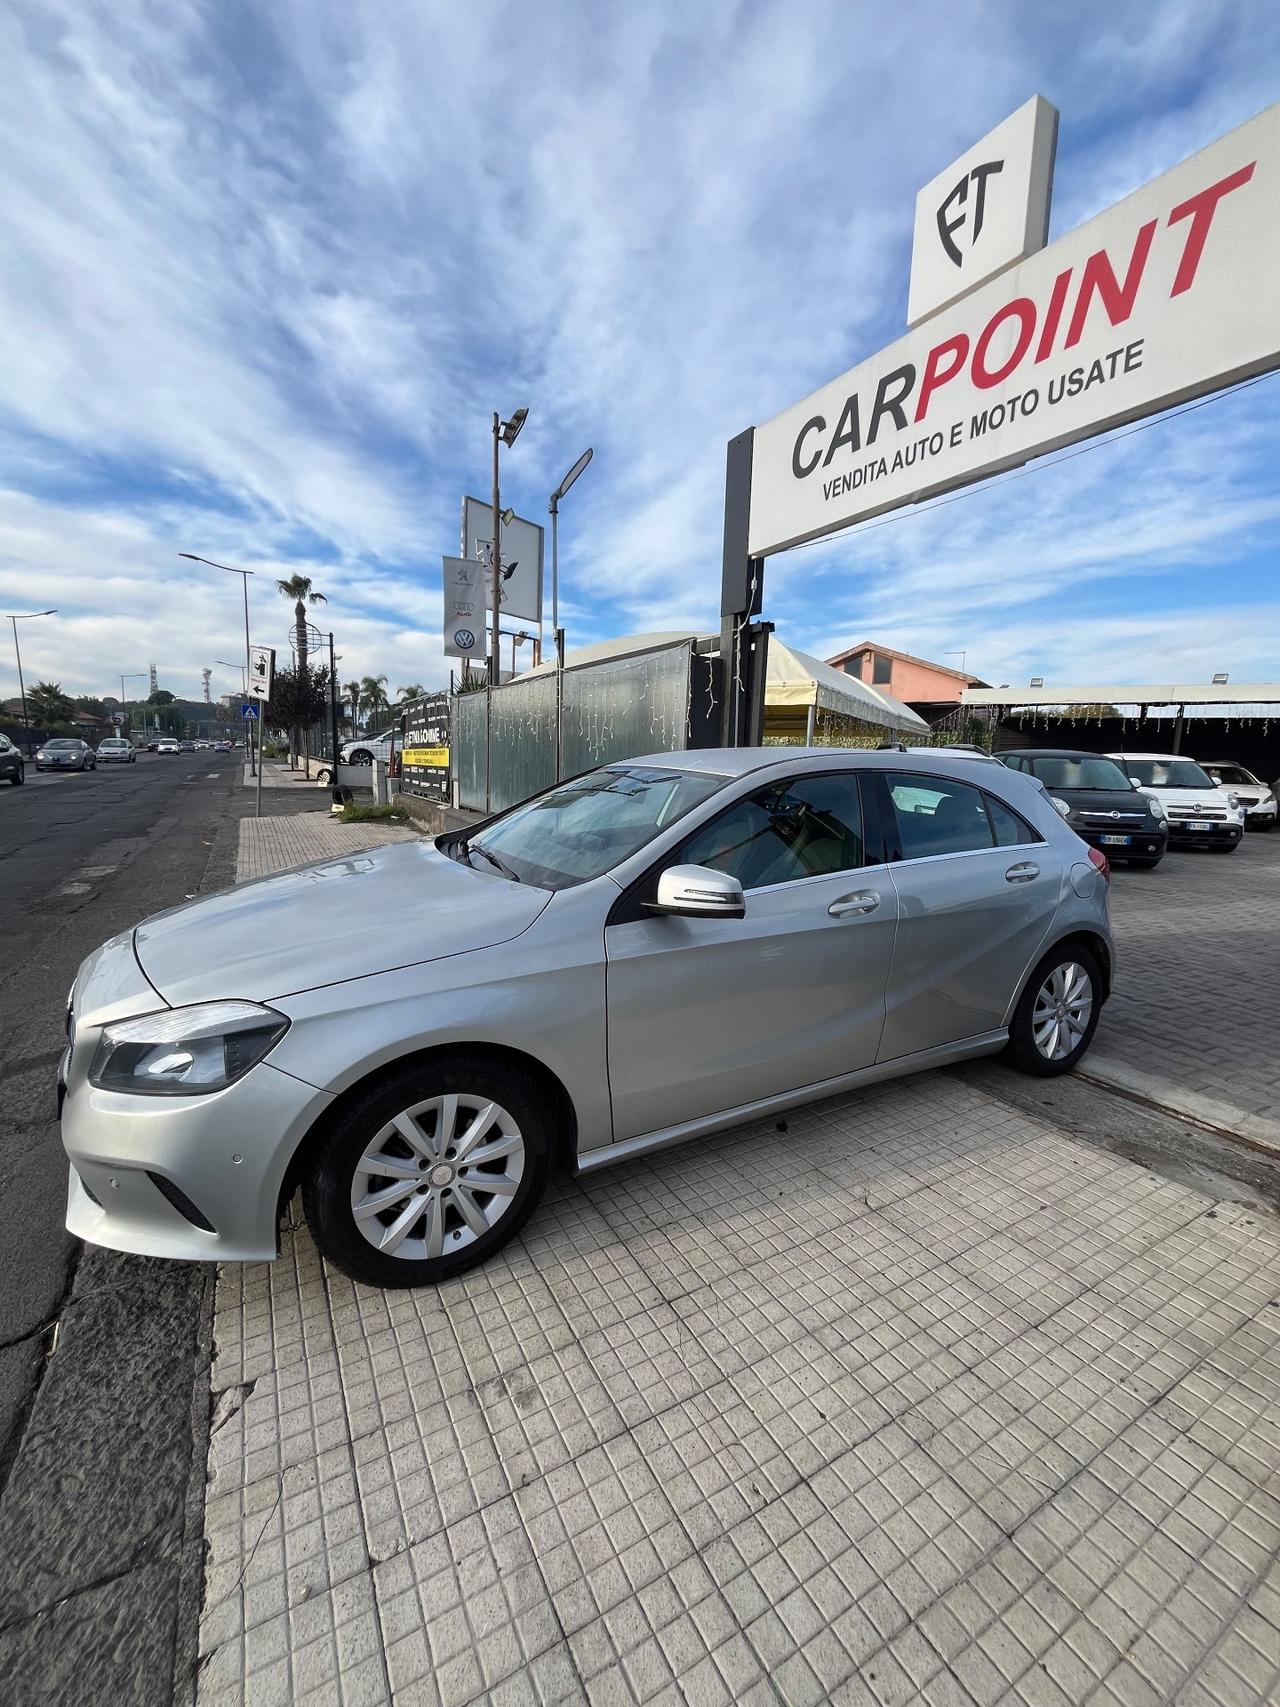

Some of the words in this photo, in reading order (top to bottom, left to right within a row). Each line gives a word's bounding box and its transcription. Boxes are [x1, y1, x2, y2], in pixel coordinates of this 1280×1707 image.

[936, 160, 1005, 268] FT
[791, 160, 1256, 480] CARPOINT
[823, 457, 888, 501] VENDITA
[891, 434, 944, 473] AUTO
[949, 421, 963, 447] E
[970, 388, 1039, 439] MOTO
[1048, 338, 1144, 405] USATE
